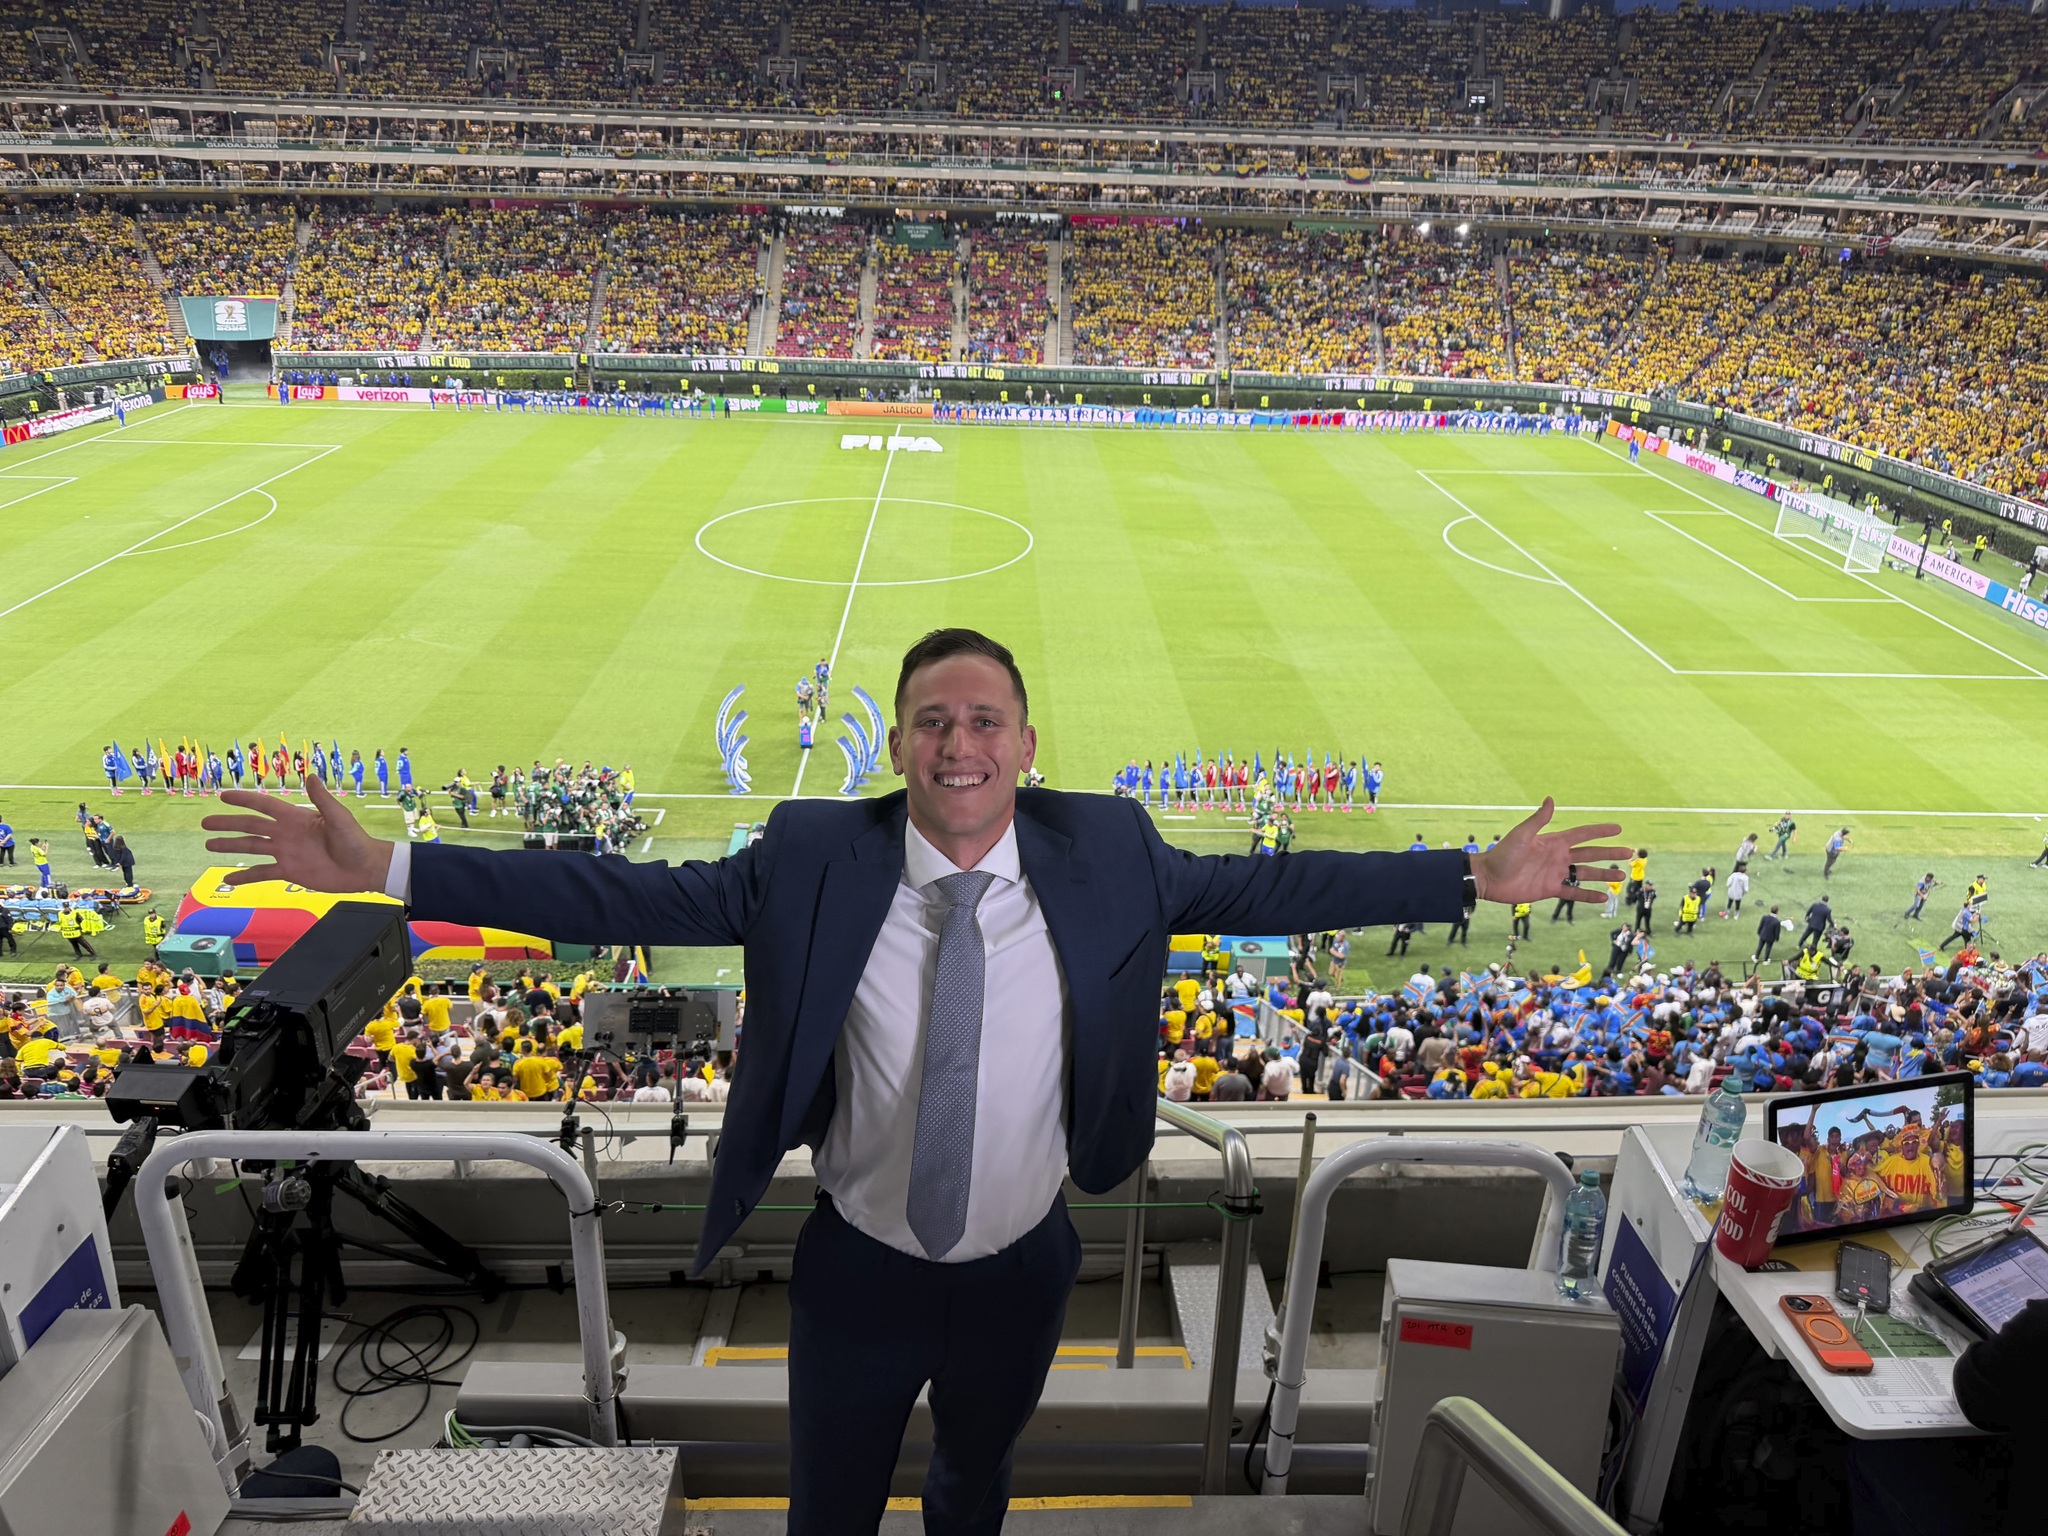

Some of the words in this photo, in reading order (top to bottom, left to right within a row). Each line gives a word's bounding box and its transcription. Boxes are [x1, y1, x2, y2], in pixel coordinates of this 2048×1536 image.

[1640, 184, 1708, 193] GUADALAJARA
[150, 362, 167, 375] IT'S
[170, 360, 192, 372] TIME
[395, 356, 417, 367] TIME
[418, 356, 430, 367] TO
[708, 359, 729, 371] TIME
[730, 360, 741, 371] TO
[936, 366, 955, 378] TIME
[956, 367, 967, 378] TO
[1160, 373, 1179, 385] TIME
[1180, 373, 1191, 385] TO
[299, 386, 323, 399] Lay's
[1342, 379, 1362, 390] TIME
[1363, 379, 1375, 391] TO
[357, 389, 409, 402] verizon
[1580, 391, 1600, 405] TIME
[1601, 392, 1613, 406] TO
[883, 405, 923, 415] JALISCO
[840, 435, 944, 452] FIFA
[1814, 440, 1831, 457] TIME
[1831, 445, 1840, 460] TO
[1685, 453, 1716, 475] verizon
[2016, 505, 2034, 526] TIME
[2036, 511, 2048, 530] TO
[1891, 540, 1914, 559] BANK
[1930, 558, 1972, 586] AMERICA
[1726, 1184, 1748, 1214] COL
[1720, 1212, 1744, 1241] COD
[81, 1286, 92, 1304] de
[1620, 1261, 1647, 1308] Puestos
[1646, 1306, 1657, 1323] de
[1611, 1268, 1658, 1346] comentaristas
[1612, 1287, 1651, 1351] Commentary
